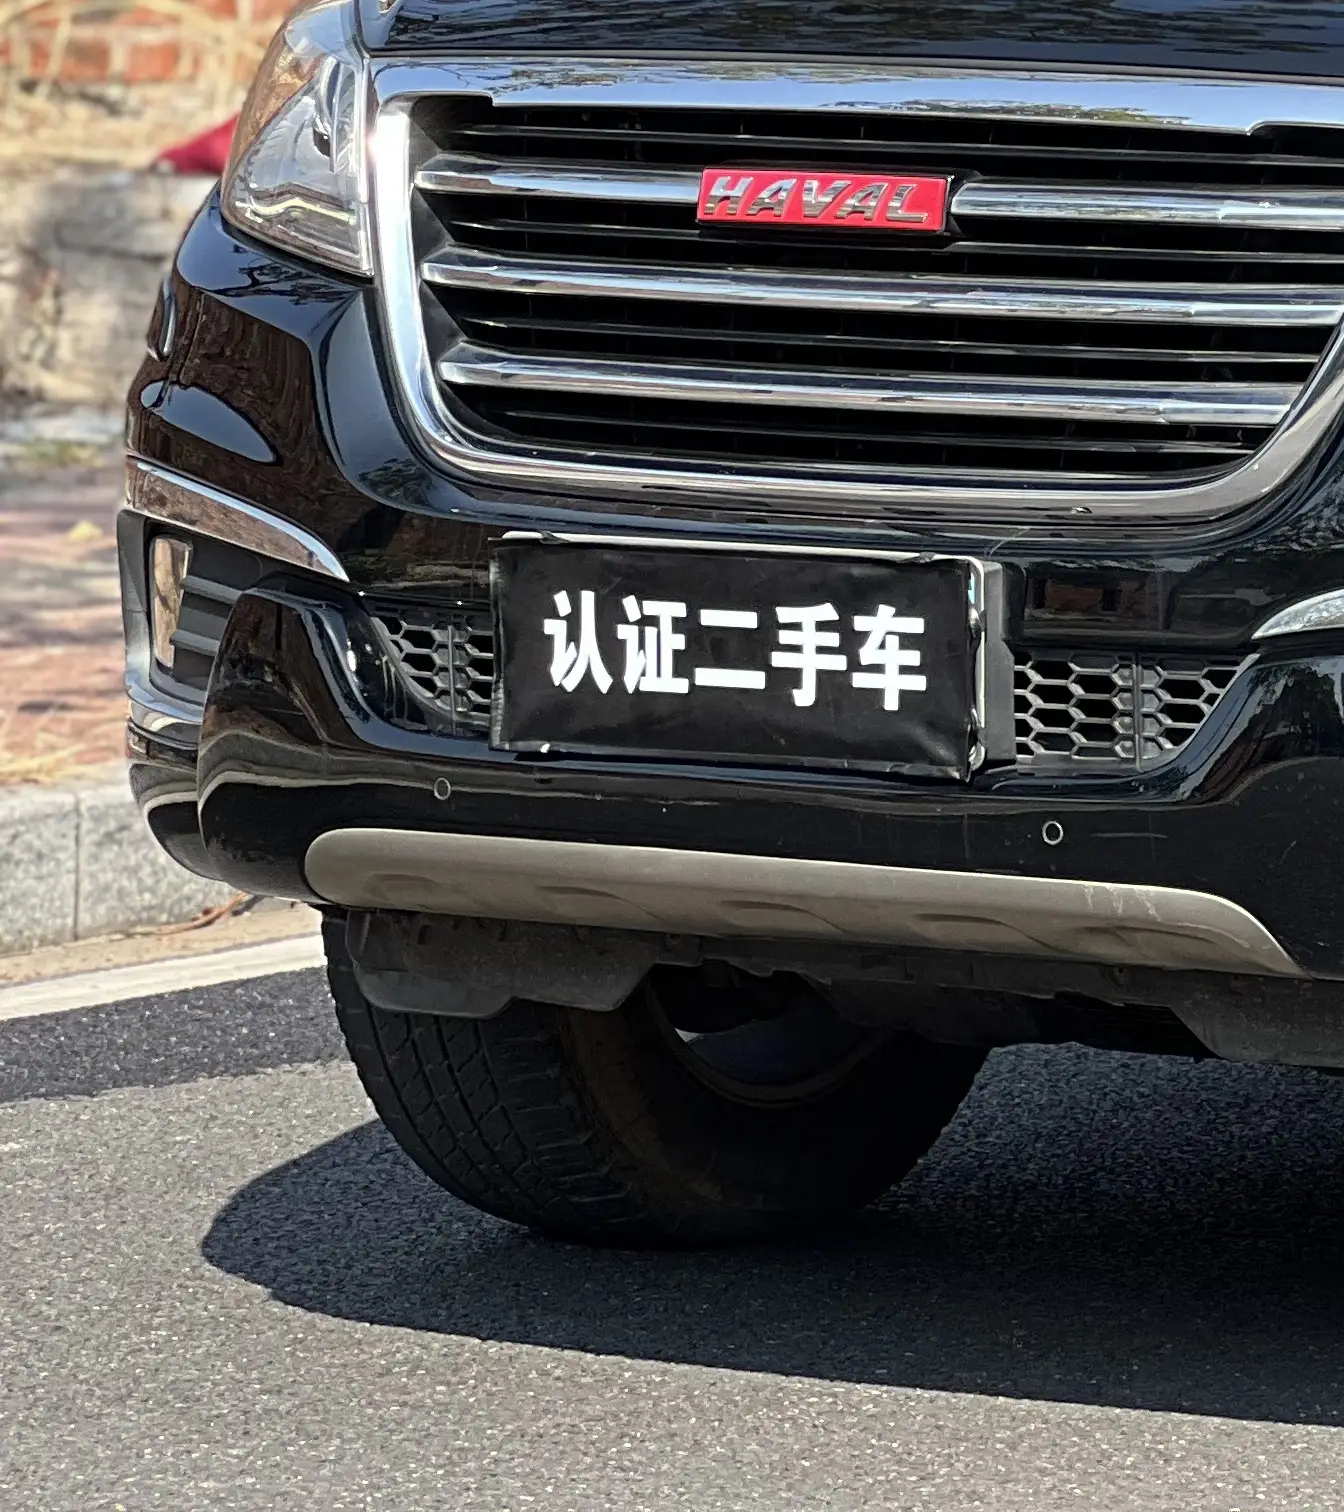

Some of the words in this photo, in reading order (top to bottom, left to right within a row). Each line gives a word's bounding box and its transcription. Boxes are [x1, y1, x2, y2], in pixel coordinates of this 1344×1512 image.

[703, 175, 929, 223] HAVAL
[543, 589, 928, 712] 认证二手车
